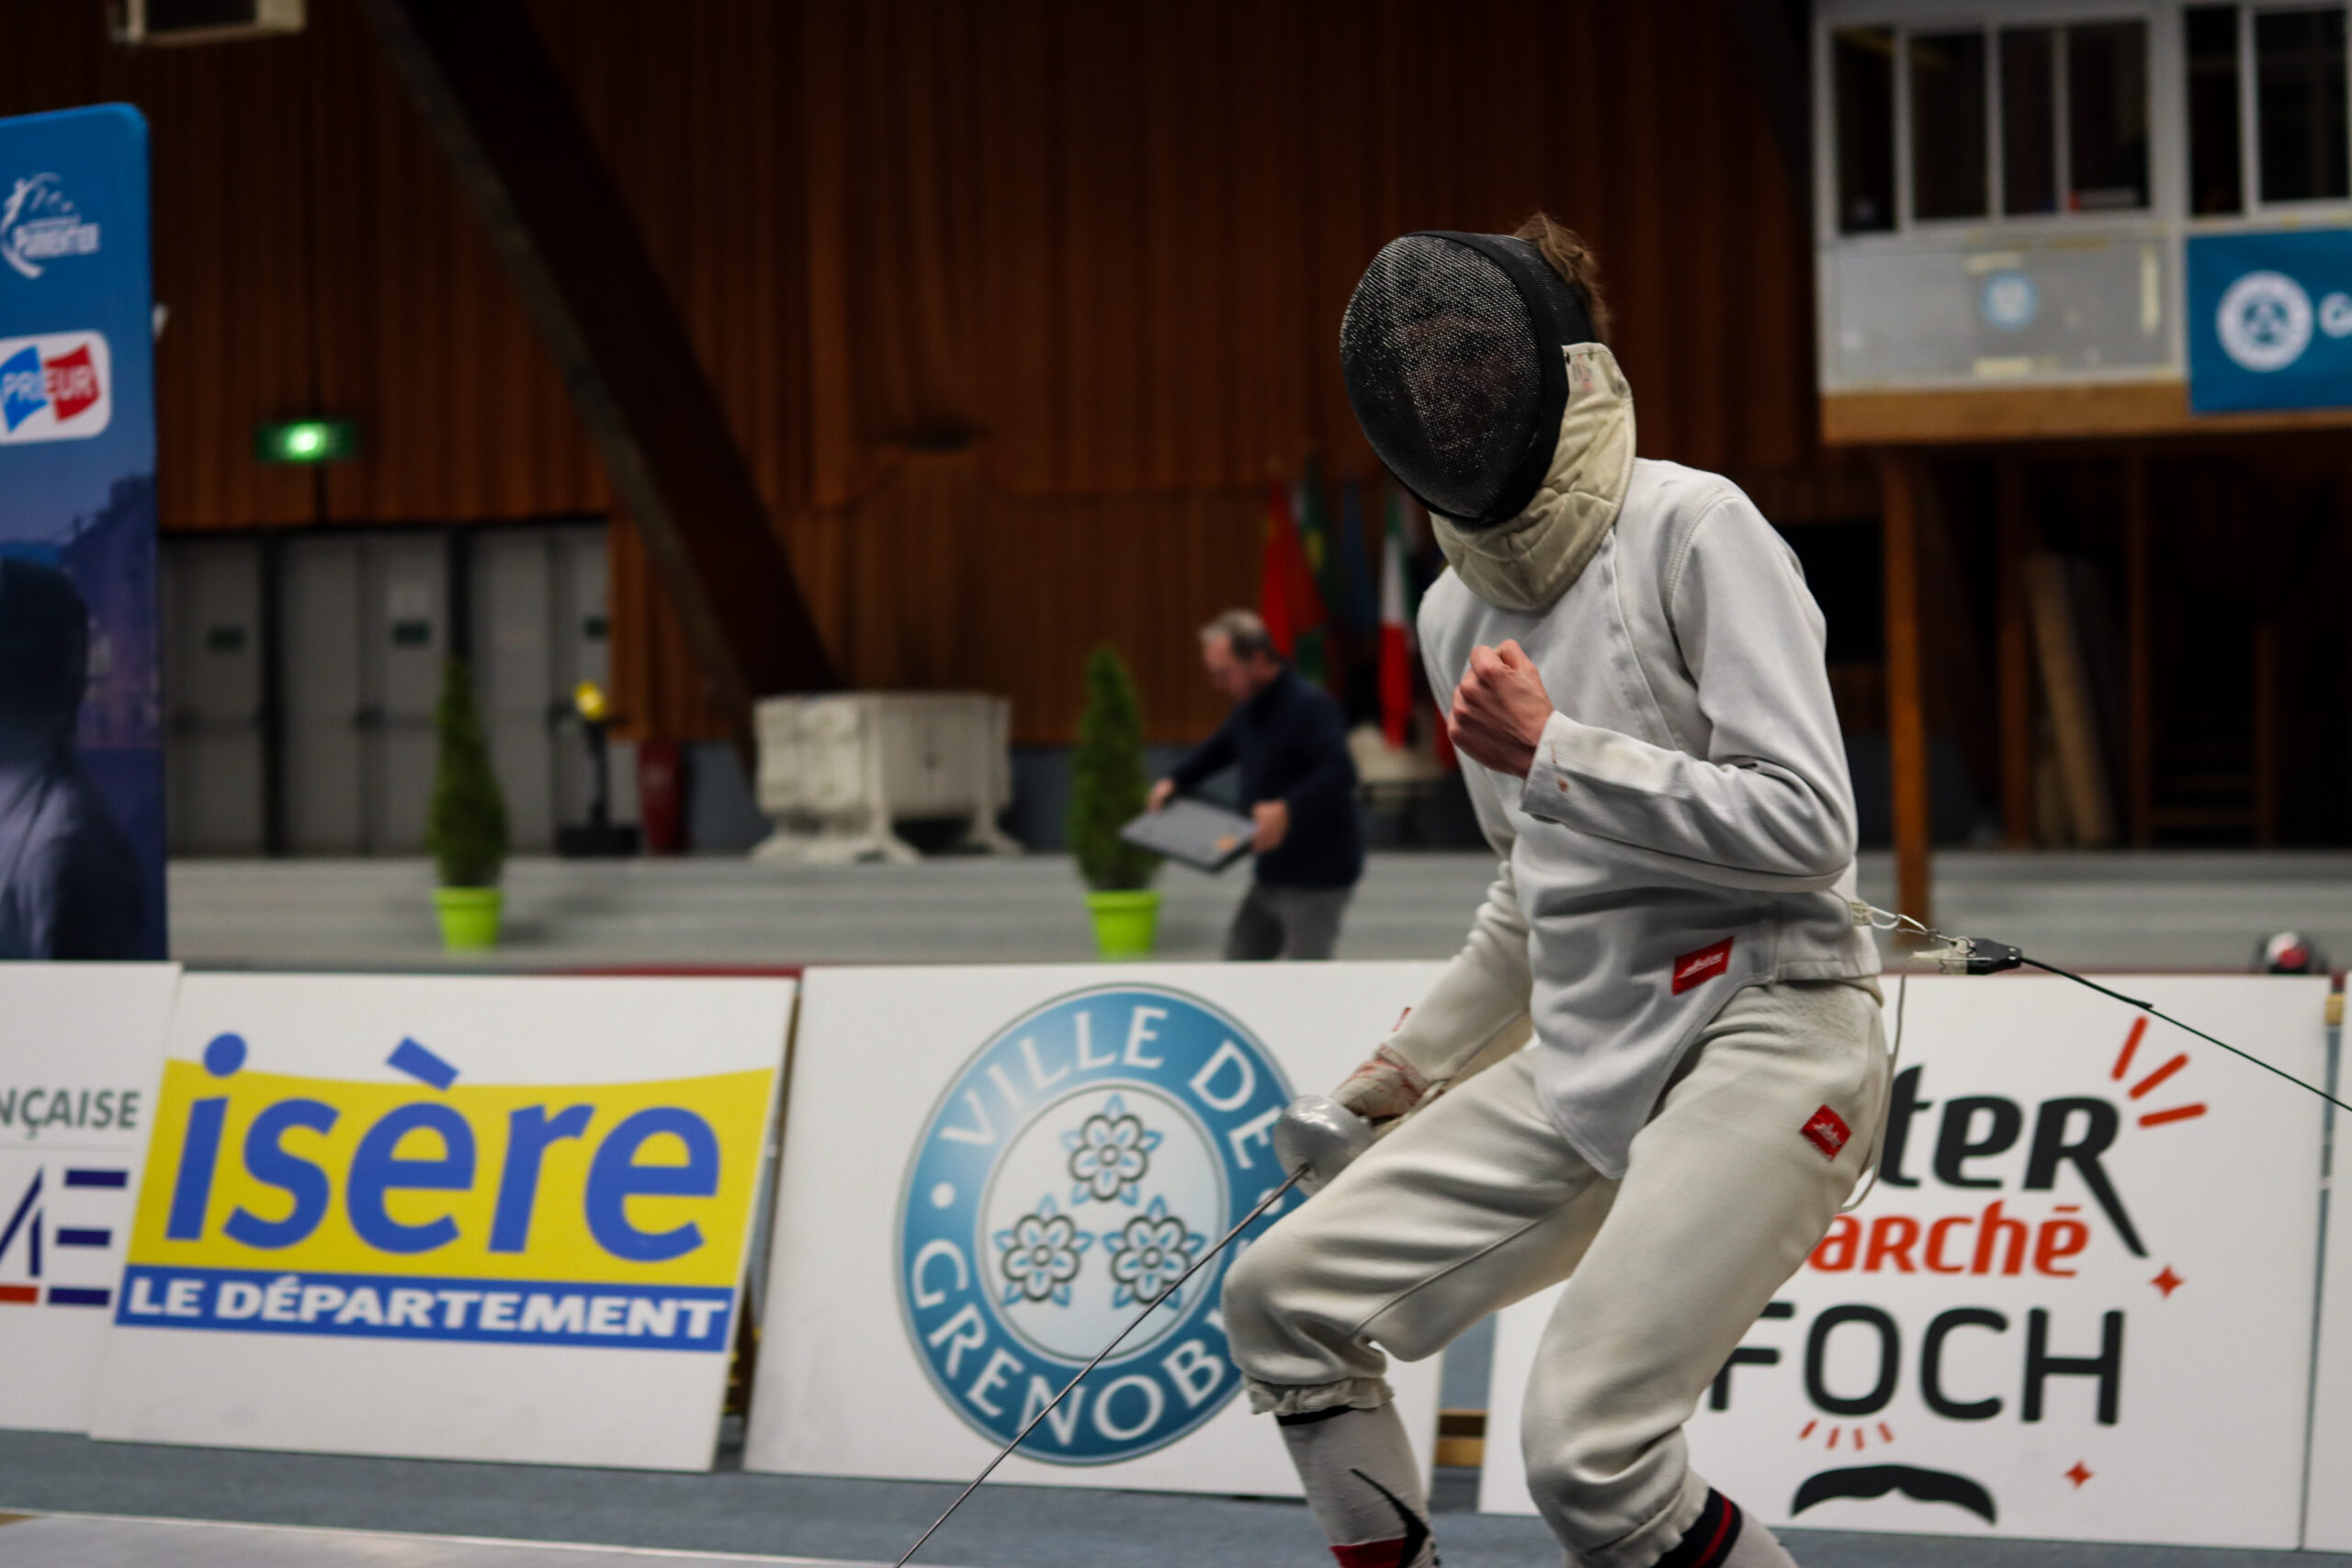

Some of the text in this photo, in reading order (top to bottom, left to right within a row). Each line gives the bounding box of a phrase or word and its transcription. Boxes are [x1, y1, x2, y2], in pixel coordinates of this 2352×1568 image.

[164, 1032, 721, 1262] isère
[939, 1005, 1283, 1169] VILLE DE
[128, 1275, 728, 1339] LE DÉPARTEMENT
[912, 1238, 1226, 1446] GRENOB
[1707, 1301, 2125, 1427] FOCH
